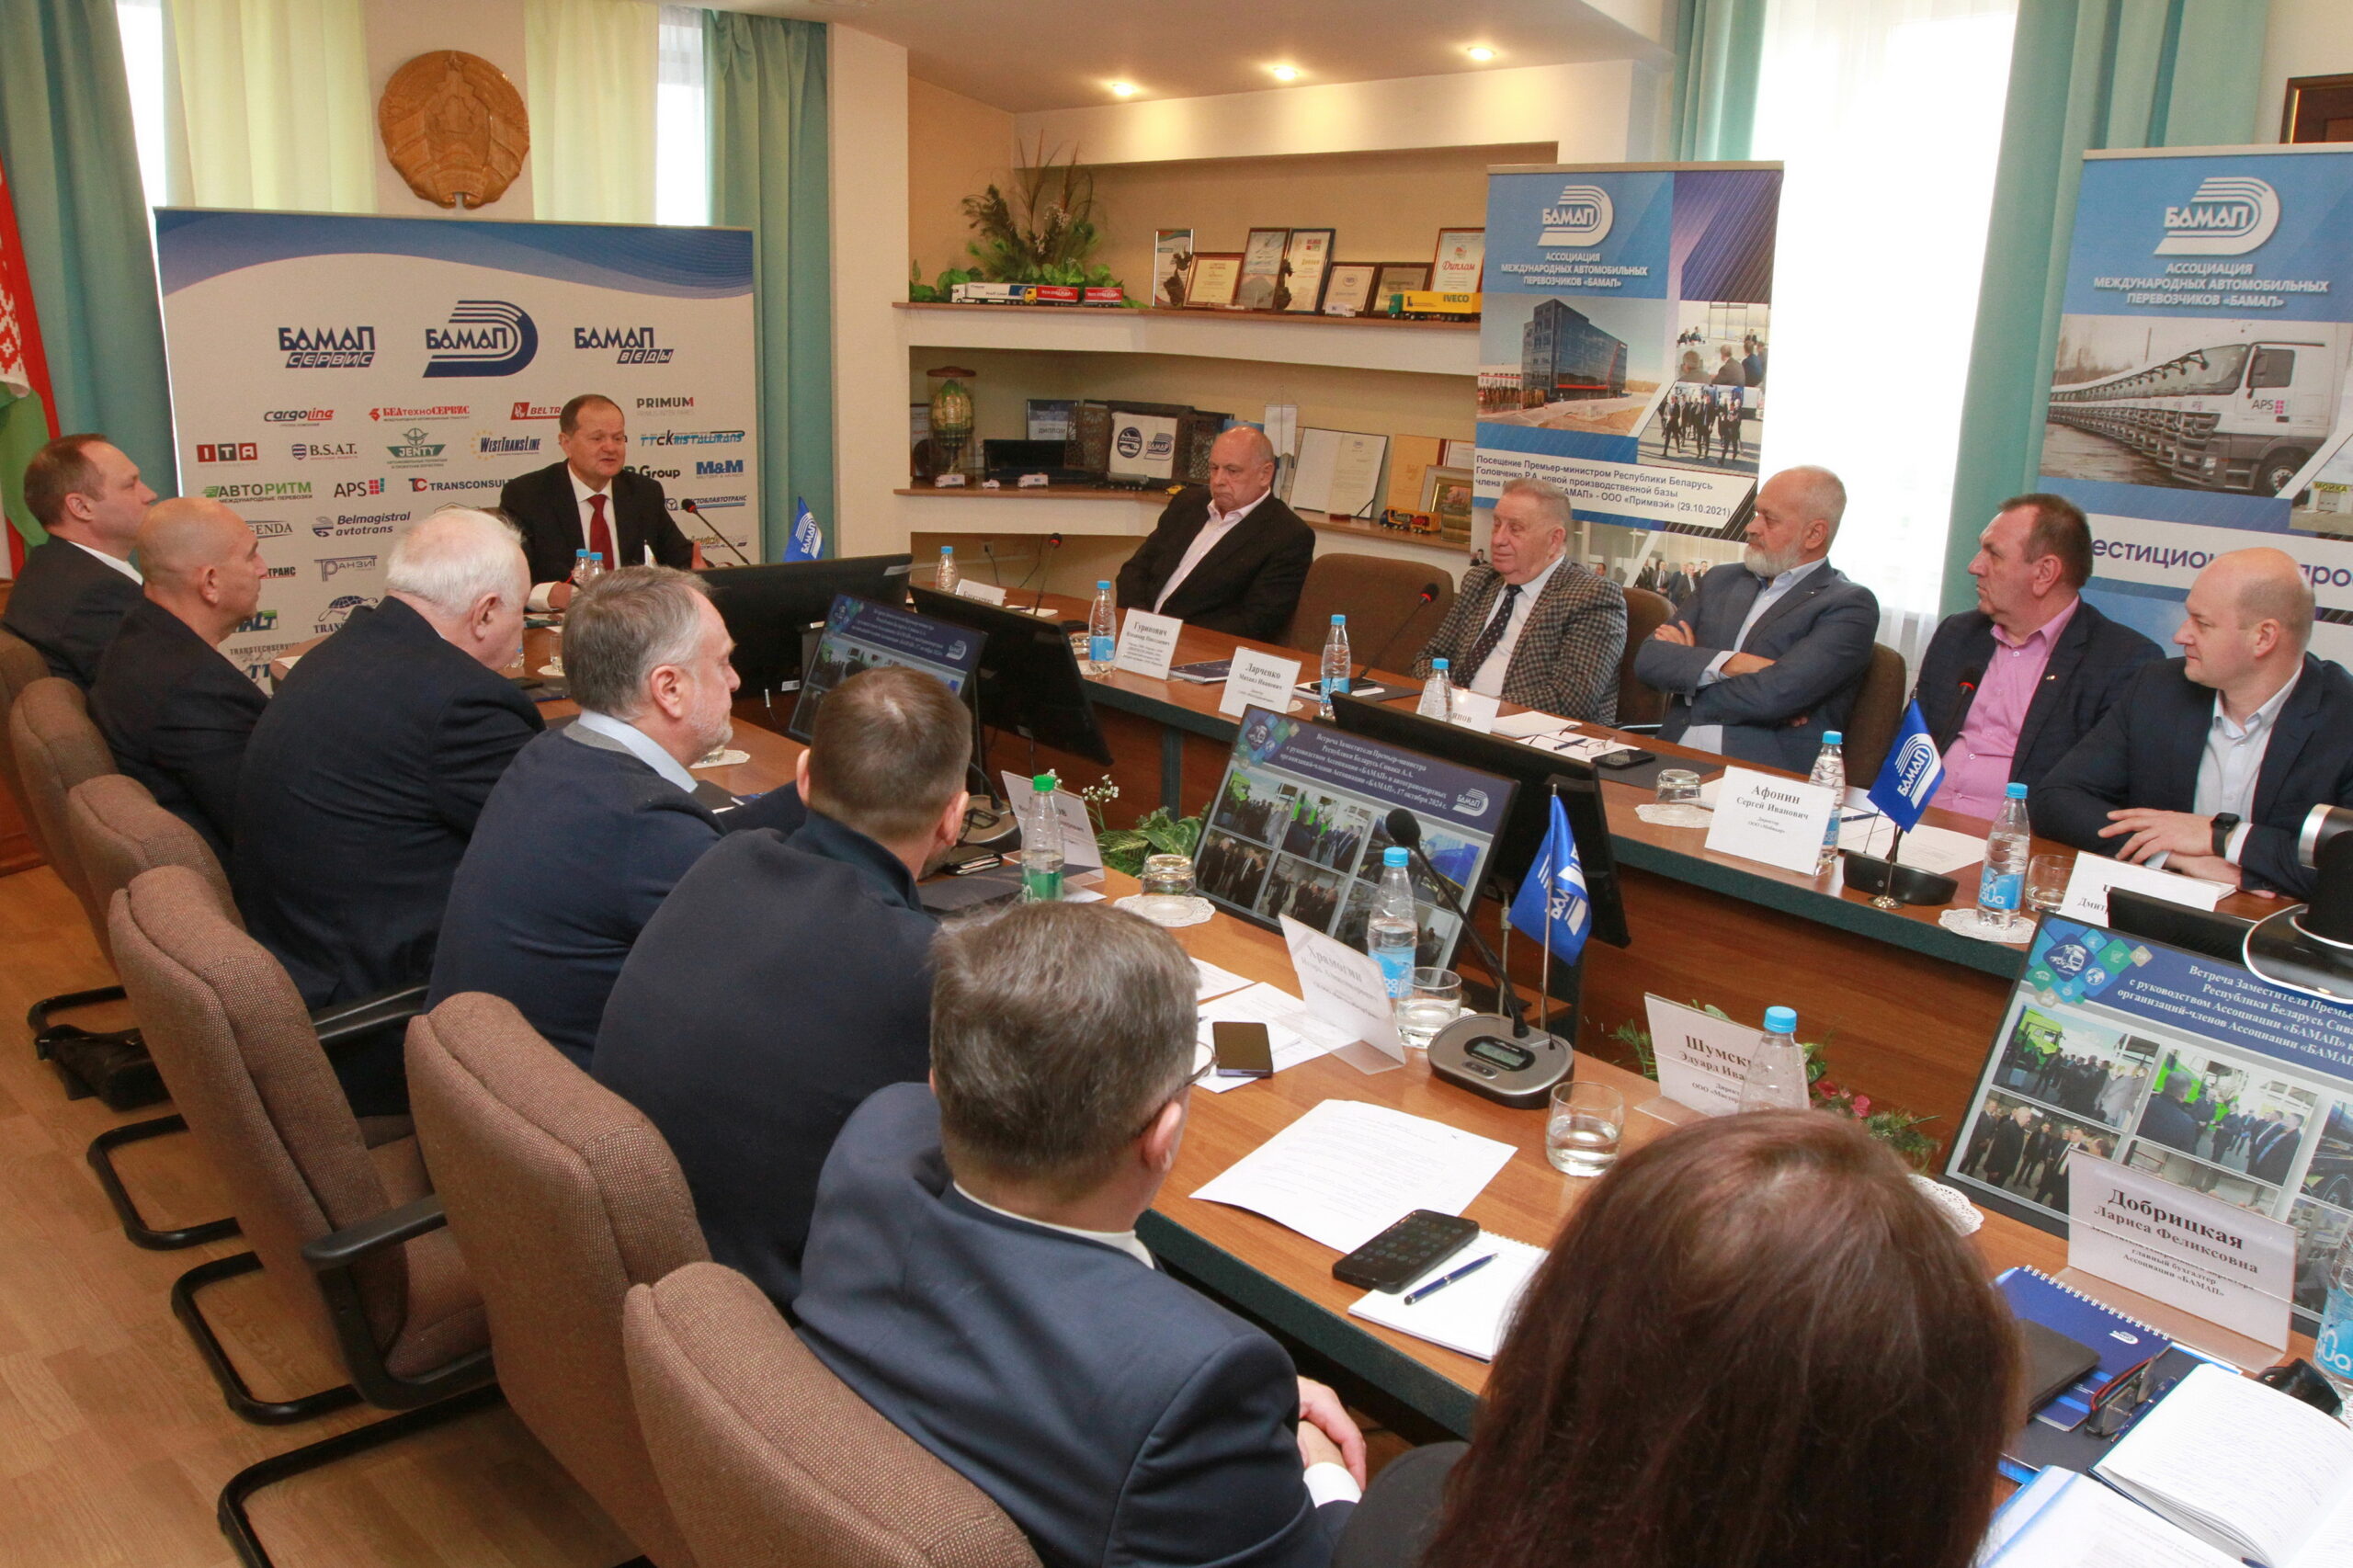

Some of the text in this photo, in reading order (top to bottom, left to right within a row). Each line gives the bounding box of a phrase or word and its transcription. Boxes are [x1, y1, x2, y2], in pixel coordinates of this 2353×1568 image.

[1542, 208, 1594, 225] БАМАП
[2164, 206, 2250, 228] БАМАП
[1546, 252, 1600, 263] АССОЦИАЦИЯ
[1501, 263, 1647, 276] МЕЖДУНАРОДНЫХ АВТОМОБИЛЬНЫХ
[2165, 263, 2253, 275] АССОЦИАЦИЯ
[1524, 276, 1621, 288] ПЕРЕВОЗЧИКОВ «БАМАП»
[2094, 278, 2329, 292] МЕЖДУНАРОДНЫХ АВТОМОБИЛЬНЫХ
[1443, 294, 1470, 303] IVECO
[2127, 292, 2285, 308] ПЕРЕВОЗЧИКОВ «БАМАП»
[278, 326, 375, 351] БАМАП
[426, 327, 507, 349] БАМАП
[574, 327, 654, 348] БАМАП
[287, 353, 374, 368] СЕРВИС
[619, 349, 673, 362] ВЕДЫ
[637, 397, 694, 408] PRIMUM
[2252, 399, 2274, 410] APS
[199, 445, 256, 460] ITA
[310, 443, 358, 456] B.S.A.T.
[399, 447, 436, 457] JENTY
[697, 460, 743, 474] M&M
[1476, 456, 1713, 491] Посещение Премьер-министром Республики Беларусь
[219, 482, 313, 497] АВТОРИТМ
[334, 482, 368, 498] APS
[1570, 478, 1652, 494] производственной
[1654, 489, 1678, 498] базы
[1560, 487, 1594, 499] АМАП»
[1601, 493, 1622, 503] ООО
[1677, 501, 1731, 518] (29.10.2021)
[337, 512, 411, 526] Belmagistral
[335, 526, 393, 537] avtotrans
[268, 566, 296, 577] ТРАНС
[313, 621, 347, 633] TRAN
[1245, 663, 1281, 679] Ларченко
[1452, 713, 1472, 724] янов
[1897, 750, 1928, 797] БАМАП
[1751, 785, 1801, 805] Афонин
[1737, 796, 1809, 820] Сергей Иванович
[2188, 965, 2353, 1020] Встреча Заместителя Премье
[2137, 980, 2211, 1009] руководством
[2213, 1002, 2281, 1029] Ассоциации
[2283, 1023, 2346, 1048] «БАМАП»
[2202, 983, 2353, 1035] Республики Беларусь Сива
[2118, 988, 2227, 1028] организаций-членов
[2228, 1022, 2298, 1050] Ассоциации
[1679, 1051, 1746, 1081] Эдуард Ива
[2108, 1188, 2243, 1250] Добрицкая
[2094, 1205, 2258, 1274] Лариса Феликсовна
[2123, 1254, 2225, 1297] Ассоциации «БАМАП»
[2172, 1262, 2217, 1285] бухгалтер
